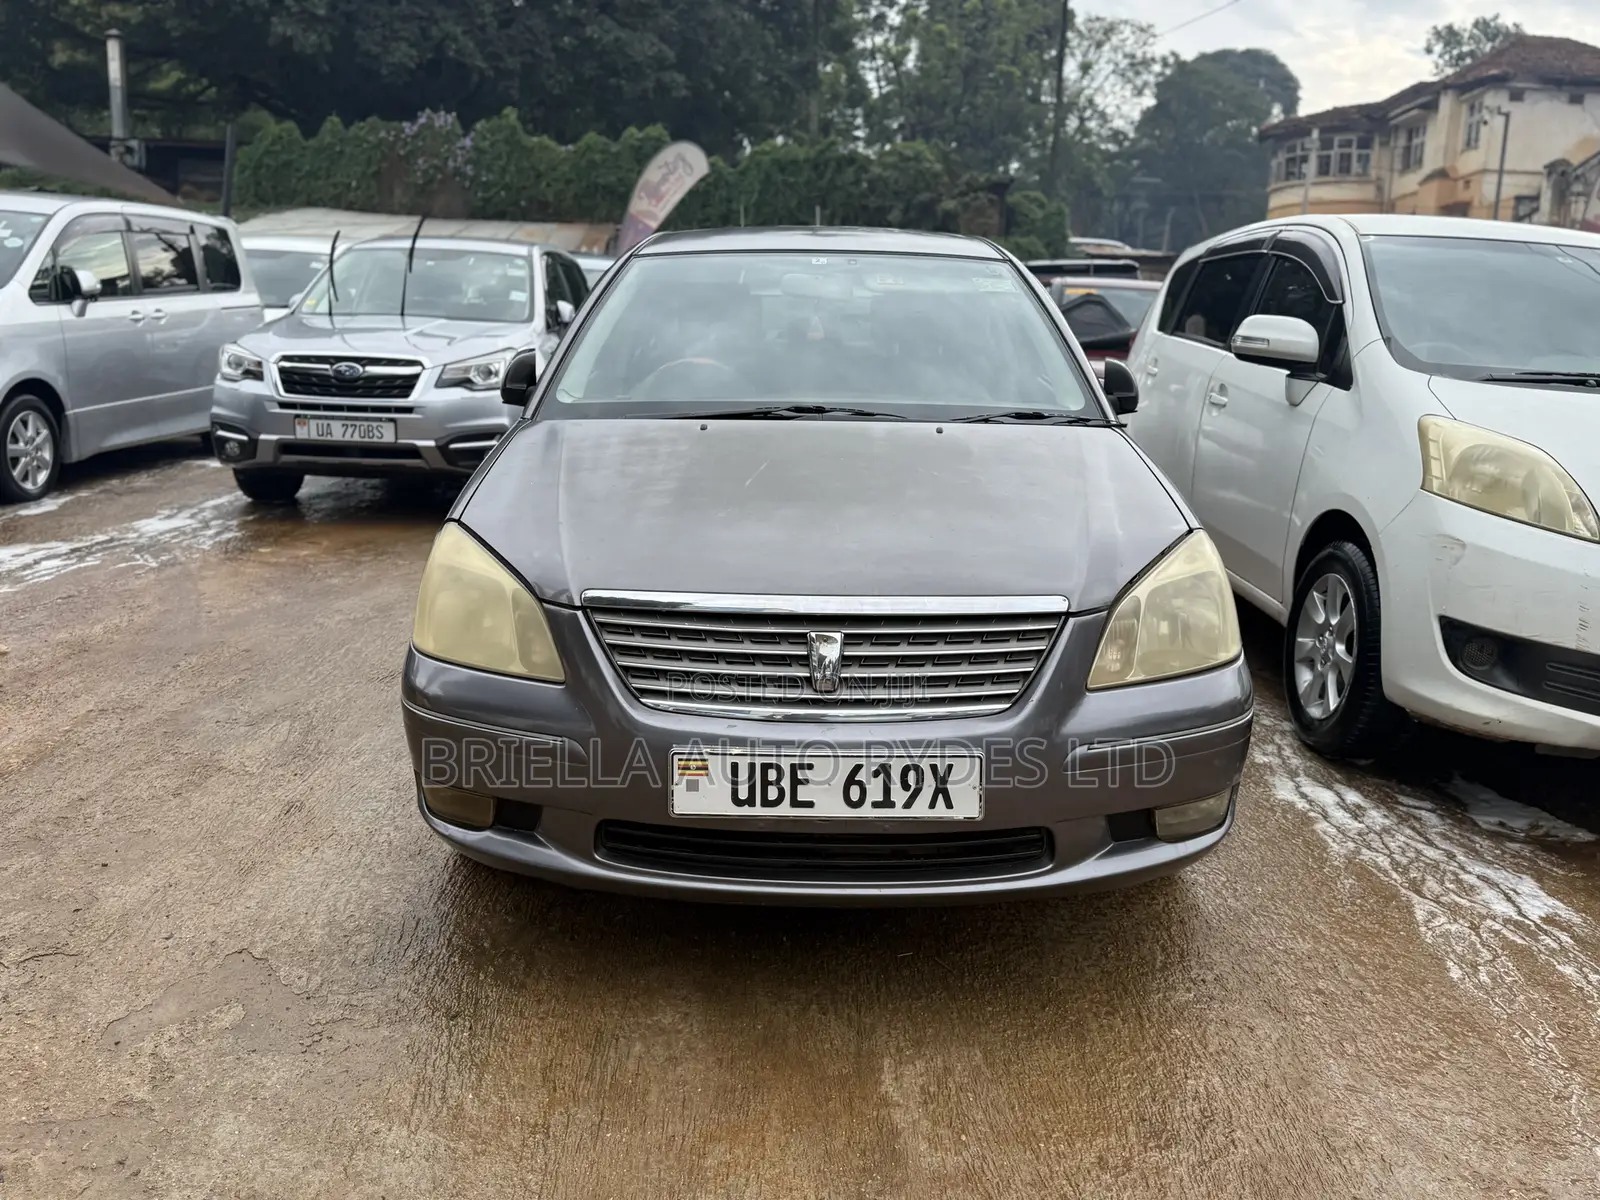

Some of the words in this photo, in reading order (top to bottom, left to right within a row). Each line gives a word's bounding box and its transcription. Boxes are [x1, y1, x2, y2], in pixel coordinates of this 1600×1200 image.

[316, 422, 334, 438] UA
[341, 423, 384, 440] 770BS
[730, 761, 816, 809] UBE
[842, 763, 954, 810] 619X
